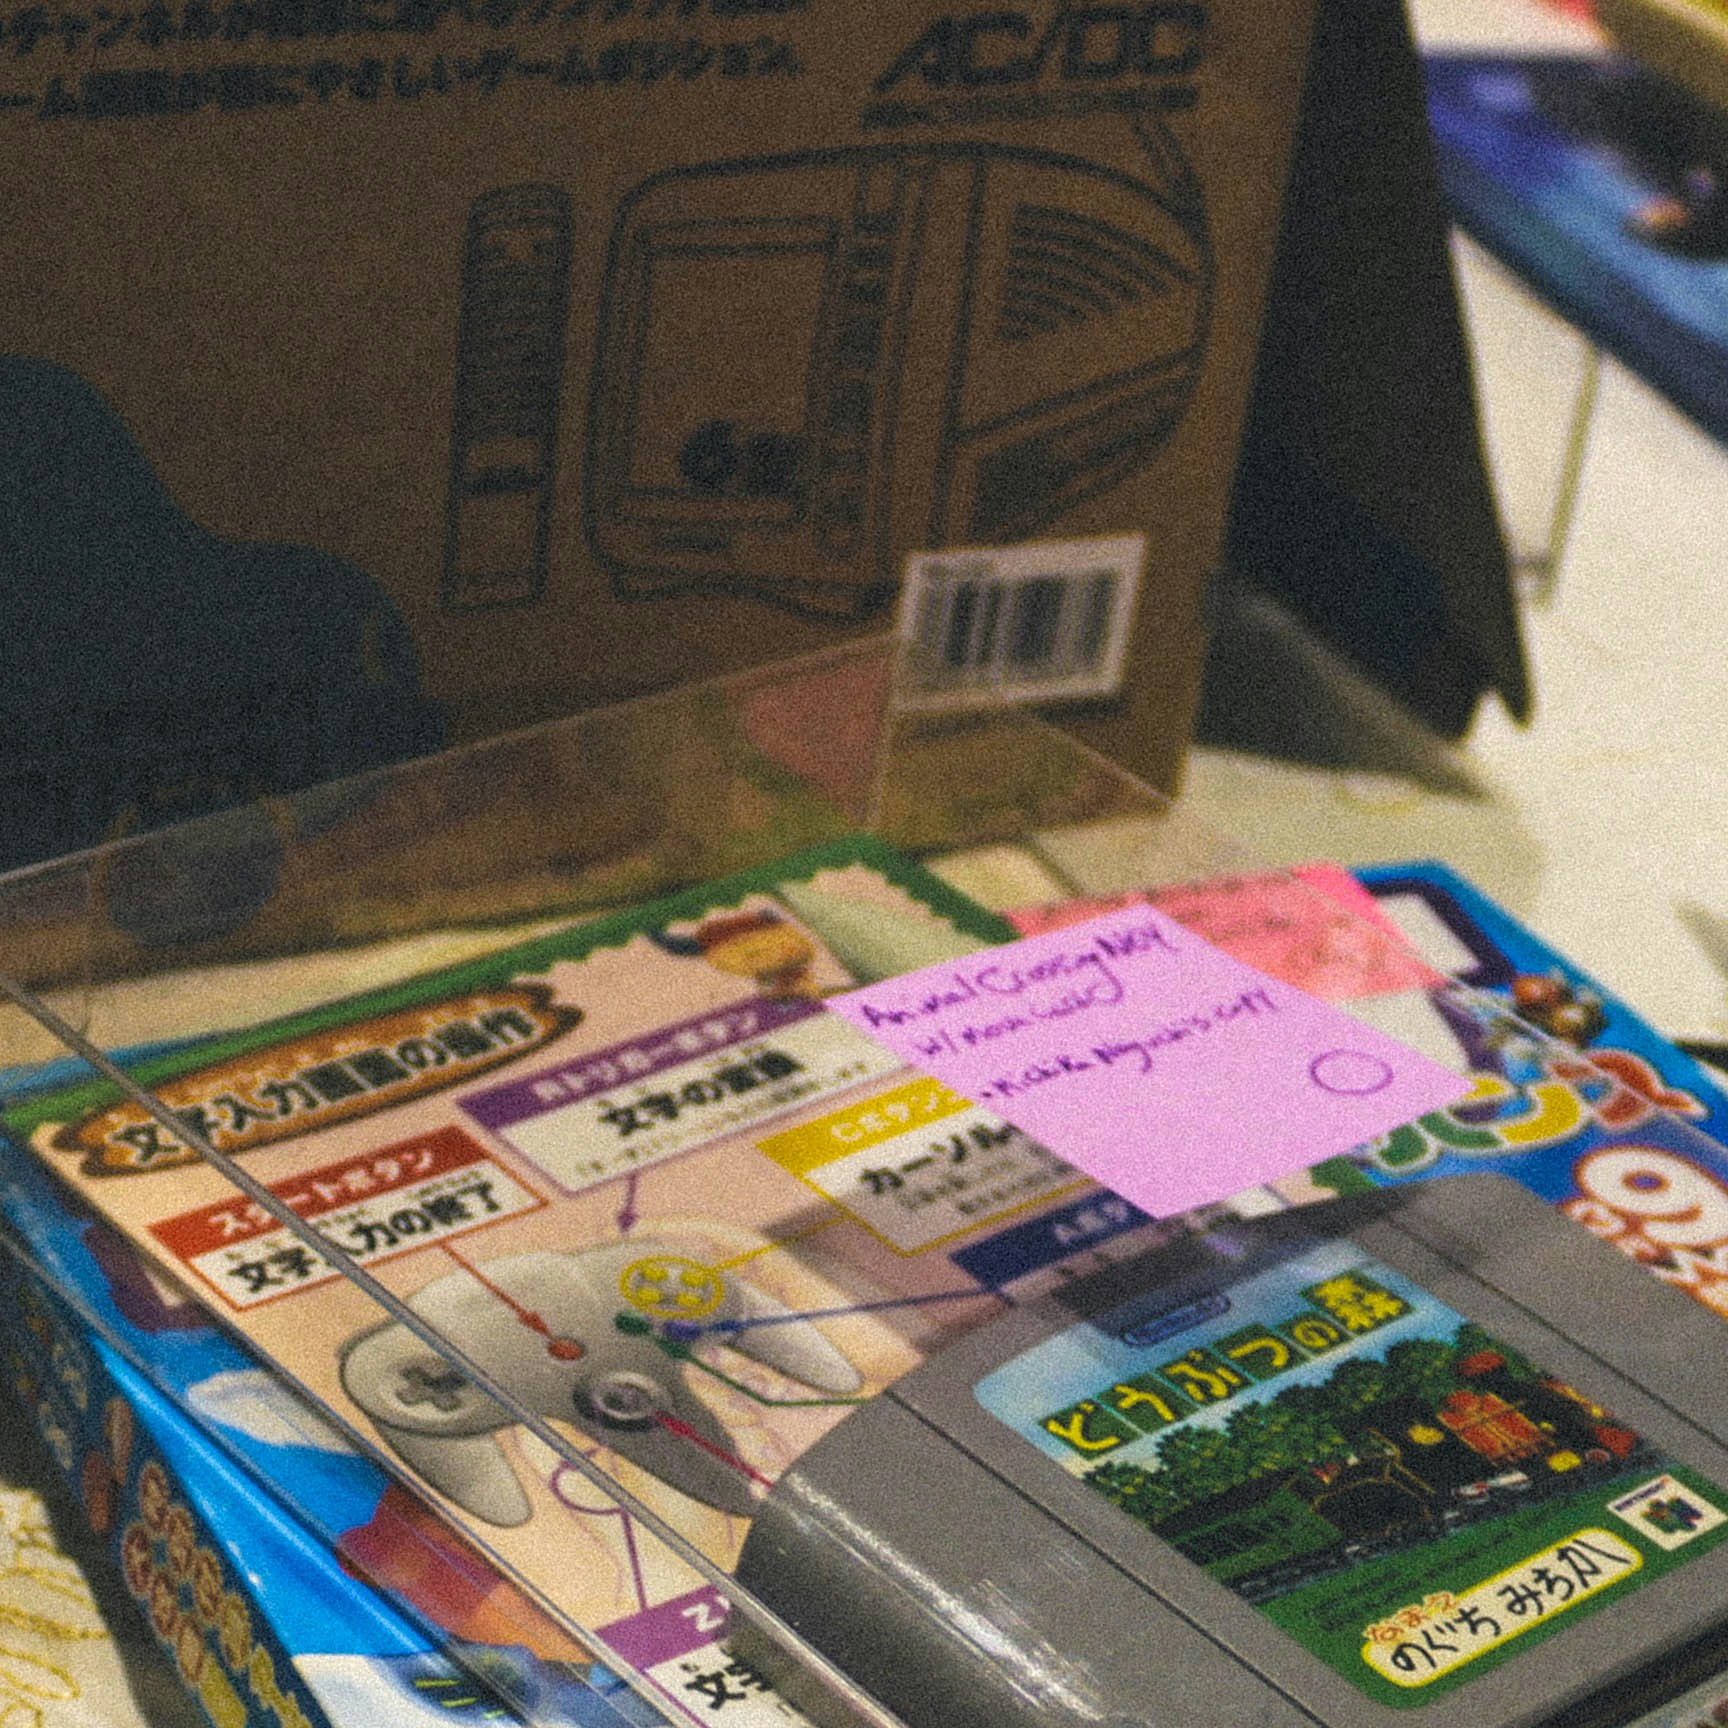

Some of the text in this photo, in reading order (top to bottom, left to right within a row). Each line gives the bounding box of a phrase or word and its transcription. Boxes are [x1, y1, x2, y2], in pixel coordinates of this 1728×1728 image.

[876, 2, 1208, 92] AC/DC
[1046, 1276, 1403, 1452] どうぶつの森
[1390, 1605, 1500, 1674] のぐち
